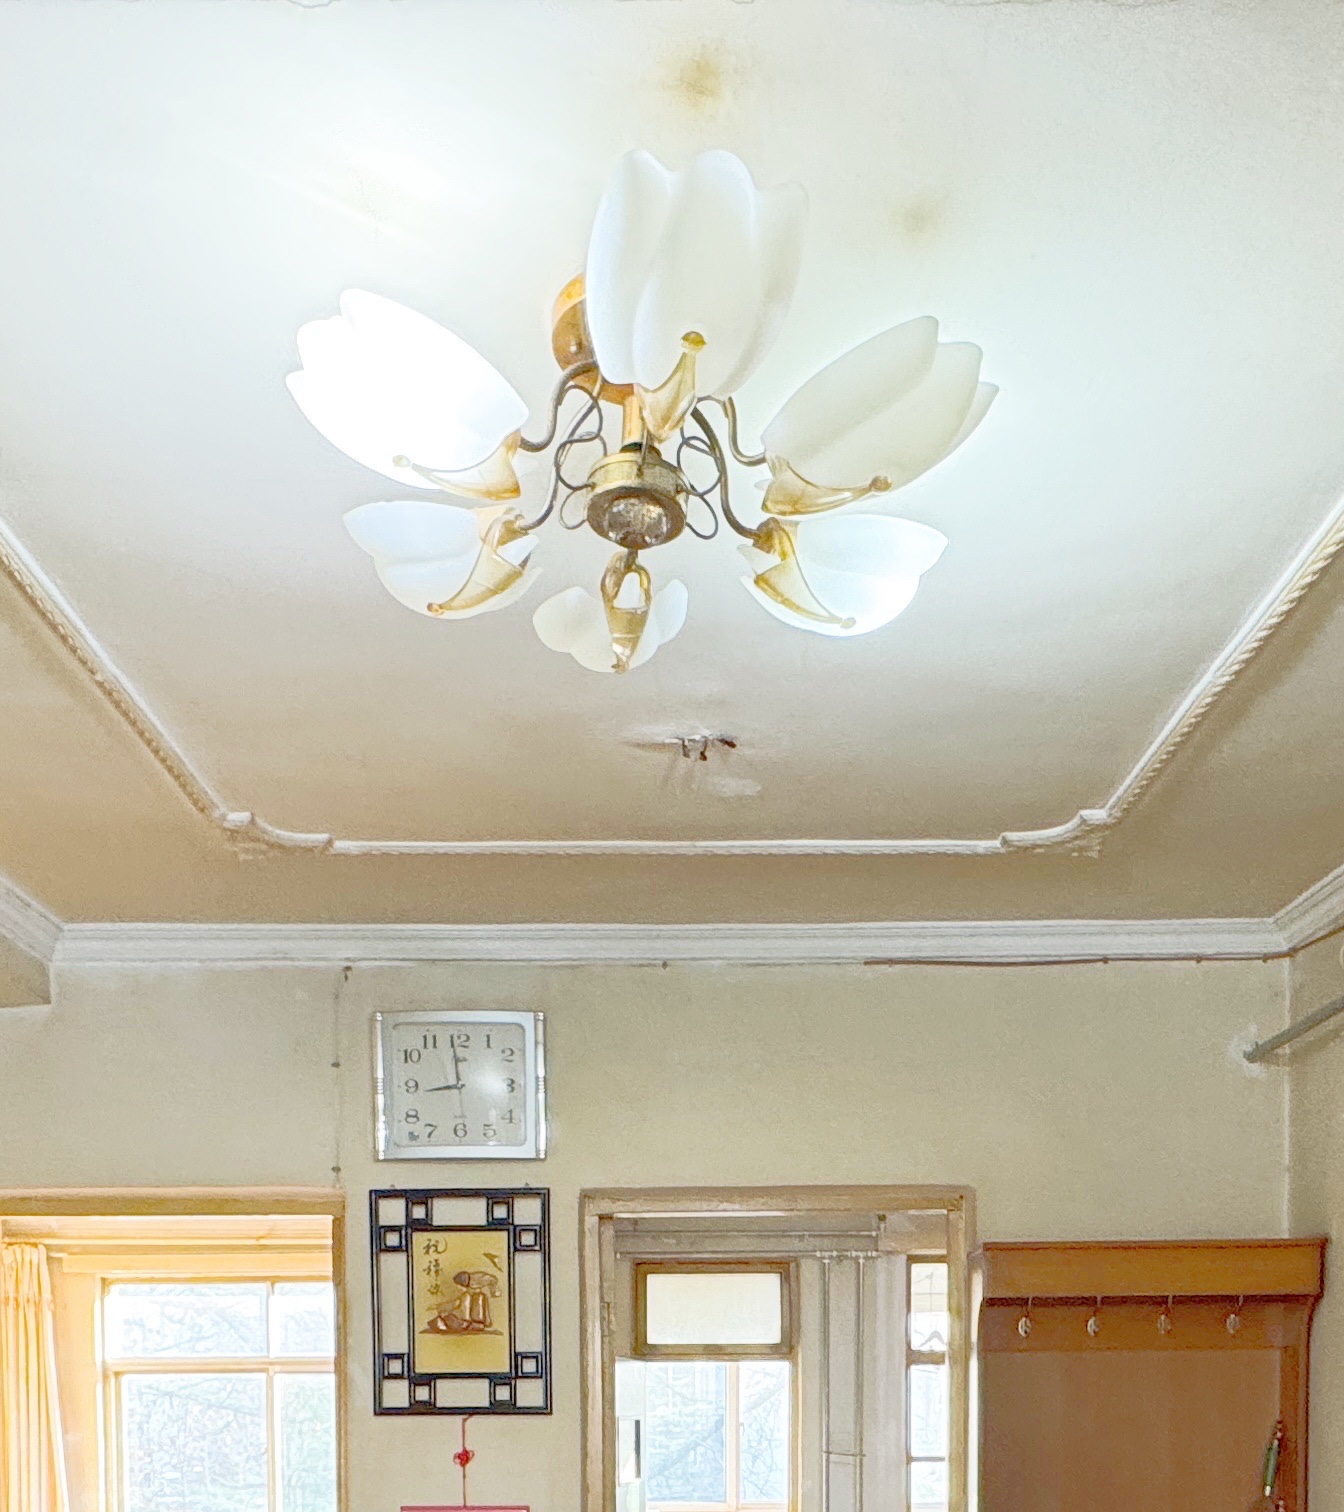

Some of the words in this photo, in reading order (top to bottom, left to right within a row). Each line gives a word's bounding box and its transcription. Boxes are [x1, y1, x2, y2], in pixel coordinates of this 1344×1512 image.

[422, 1033, 438, 1049] 11
[450, 1033, 470, 1049] 12
[485, 1034, 492, 1049] 1
[403, 1048, 421, 1064] 10
[501, 1048, 514, 1063] 2
[404, 1079, 419, 1094] 9
[504, 1078, 515, 1094] 3
[404, 1108, 419, 1124] 8
[501, 1108, 515, 1124] 4
[424, 1123, 438, 1139] 7
[453, 1123, 468, 1138] 6
[483, 1124, 497, 1139] 5
